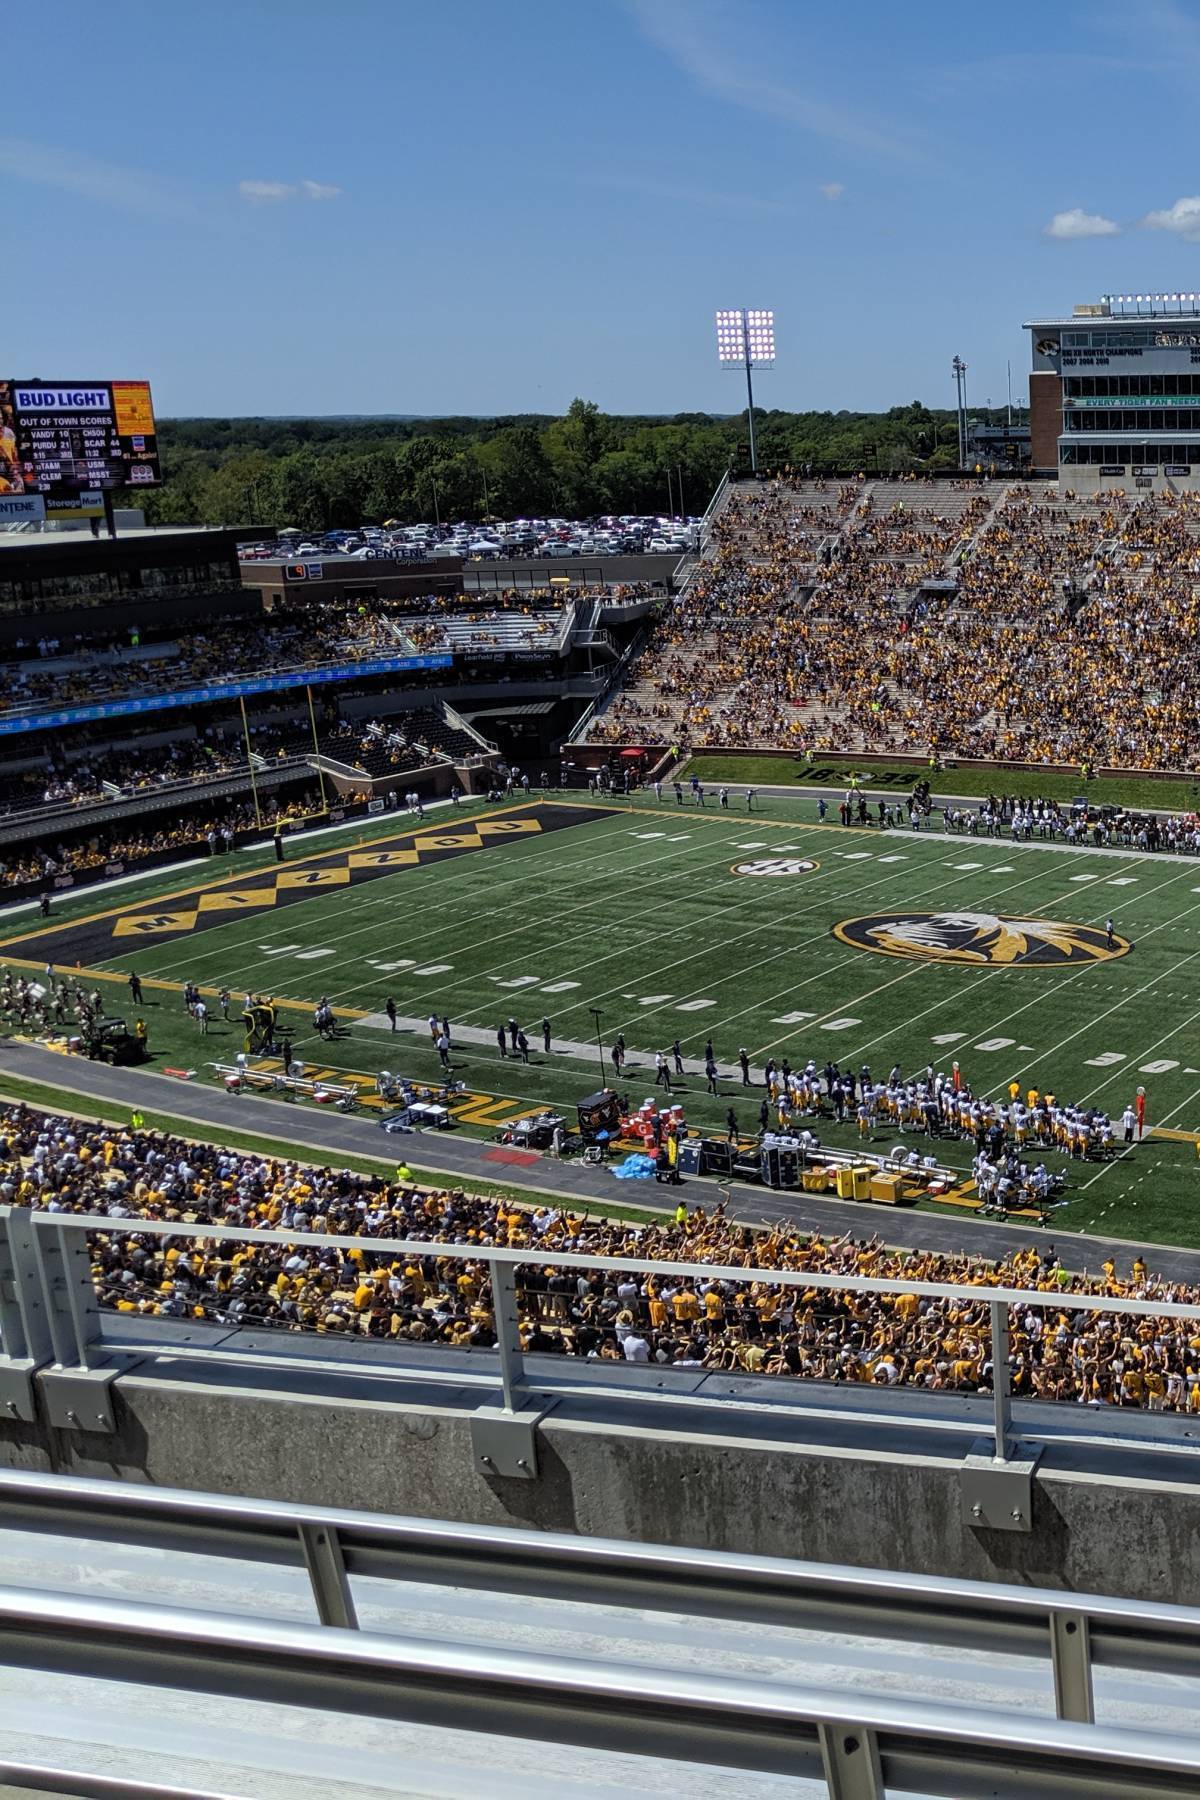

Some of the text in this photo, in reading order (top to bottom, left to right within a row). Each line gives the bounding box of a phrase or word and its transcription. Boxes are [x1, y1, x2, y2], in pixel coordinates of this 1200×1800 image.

[1106, 348, 1143, 356] CHAMPIONS
[1062, 358, 1076, 366] 2007
[19, 392, 105, 406] BUD LIGHT
[20, 418, 38, 426] OUT
[40, 418, 51, 426] OF
[80, 417, 112, 425] SCORES
[31, 431, 55, 439] VANDY
[41, 473, 62, 481] CLEM
[89, 471, 110, 479] MSST
[47, 497, 103, 509] Storage Mart
[366, 549, 427, 560] CENTENE
[396, 557, 437, 566] Corporation
[638, 1124, 647, 1133] G
